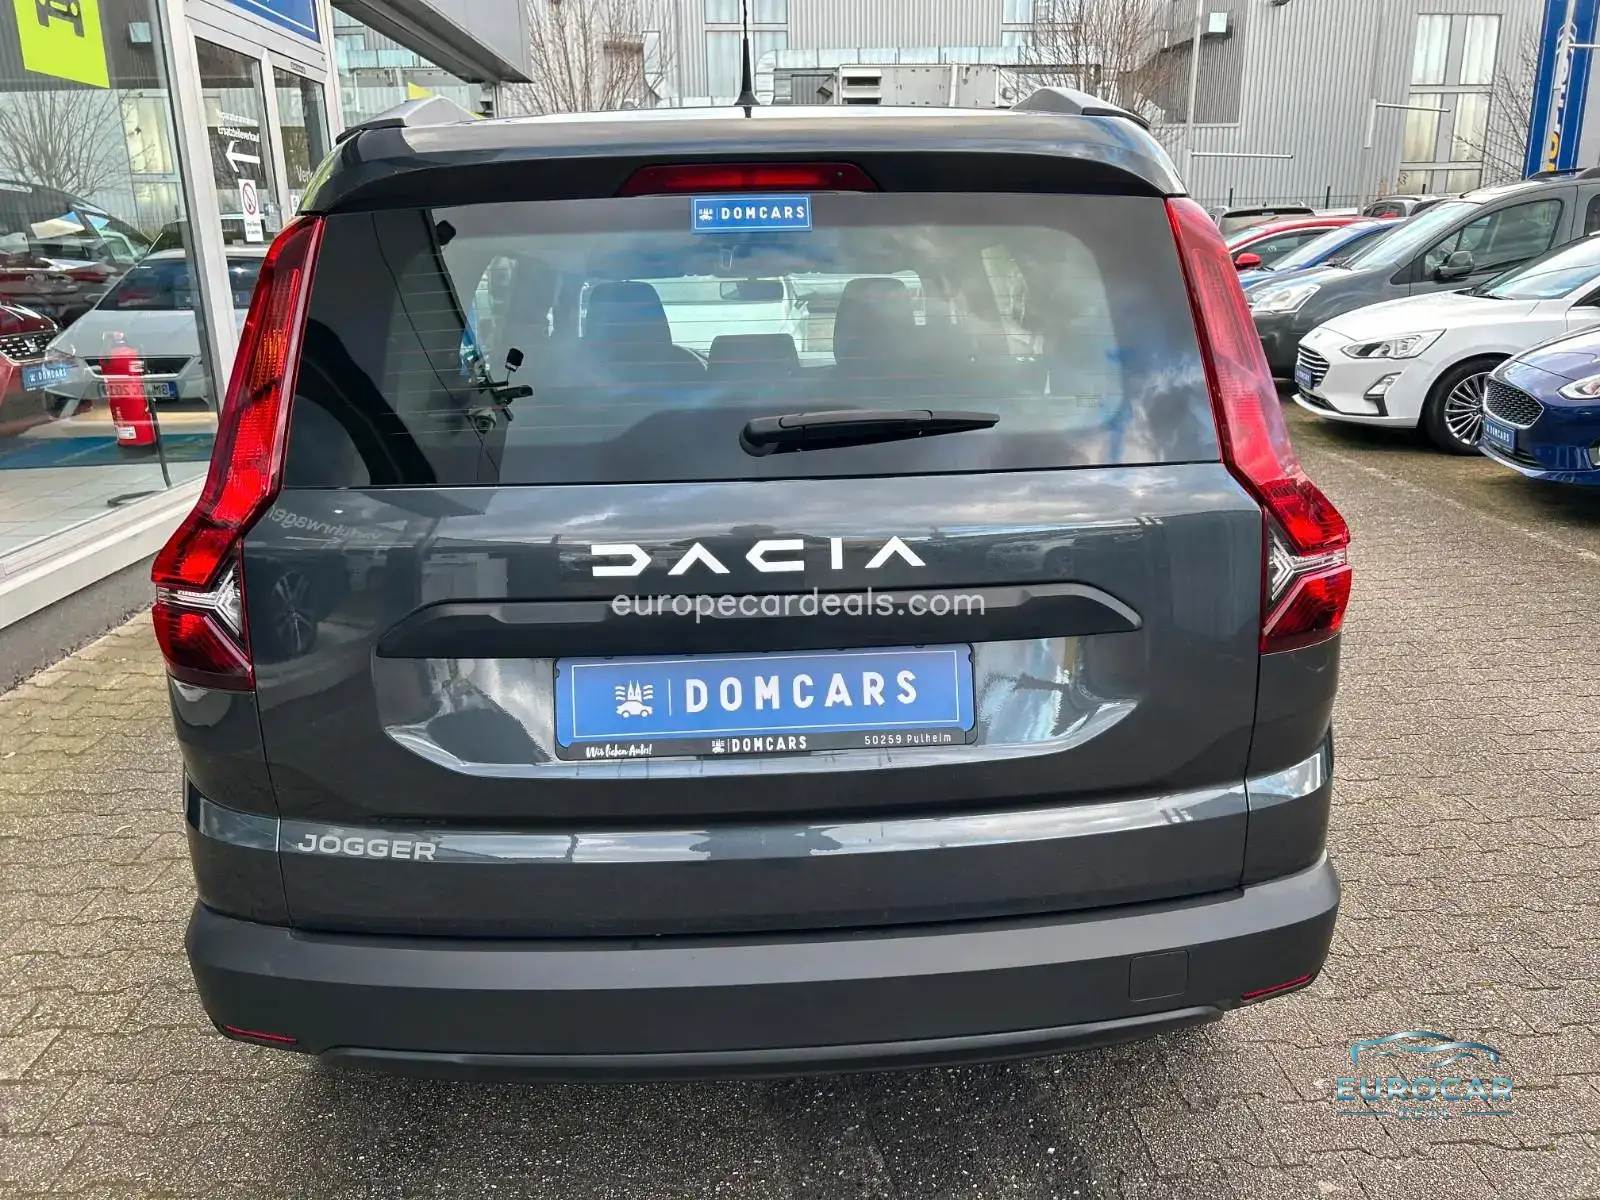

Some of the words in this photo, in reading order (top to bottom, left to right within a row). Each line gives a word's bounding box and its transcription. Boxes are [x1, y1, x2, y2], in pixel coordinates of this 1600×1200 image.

[721, 206, 805, 220] DOMCARS
[591, 535, 927, 577] DACIA
[685, 670, 918, 713] DOMCARS
[731, 736, 807, 752] DOMCARS
[864, 734, 902, 745] 50259
[906, 733, 952, 744] Pulheim
[297, 833, 436, 861] JOGGER
